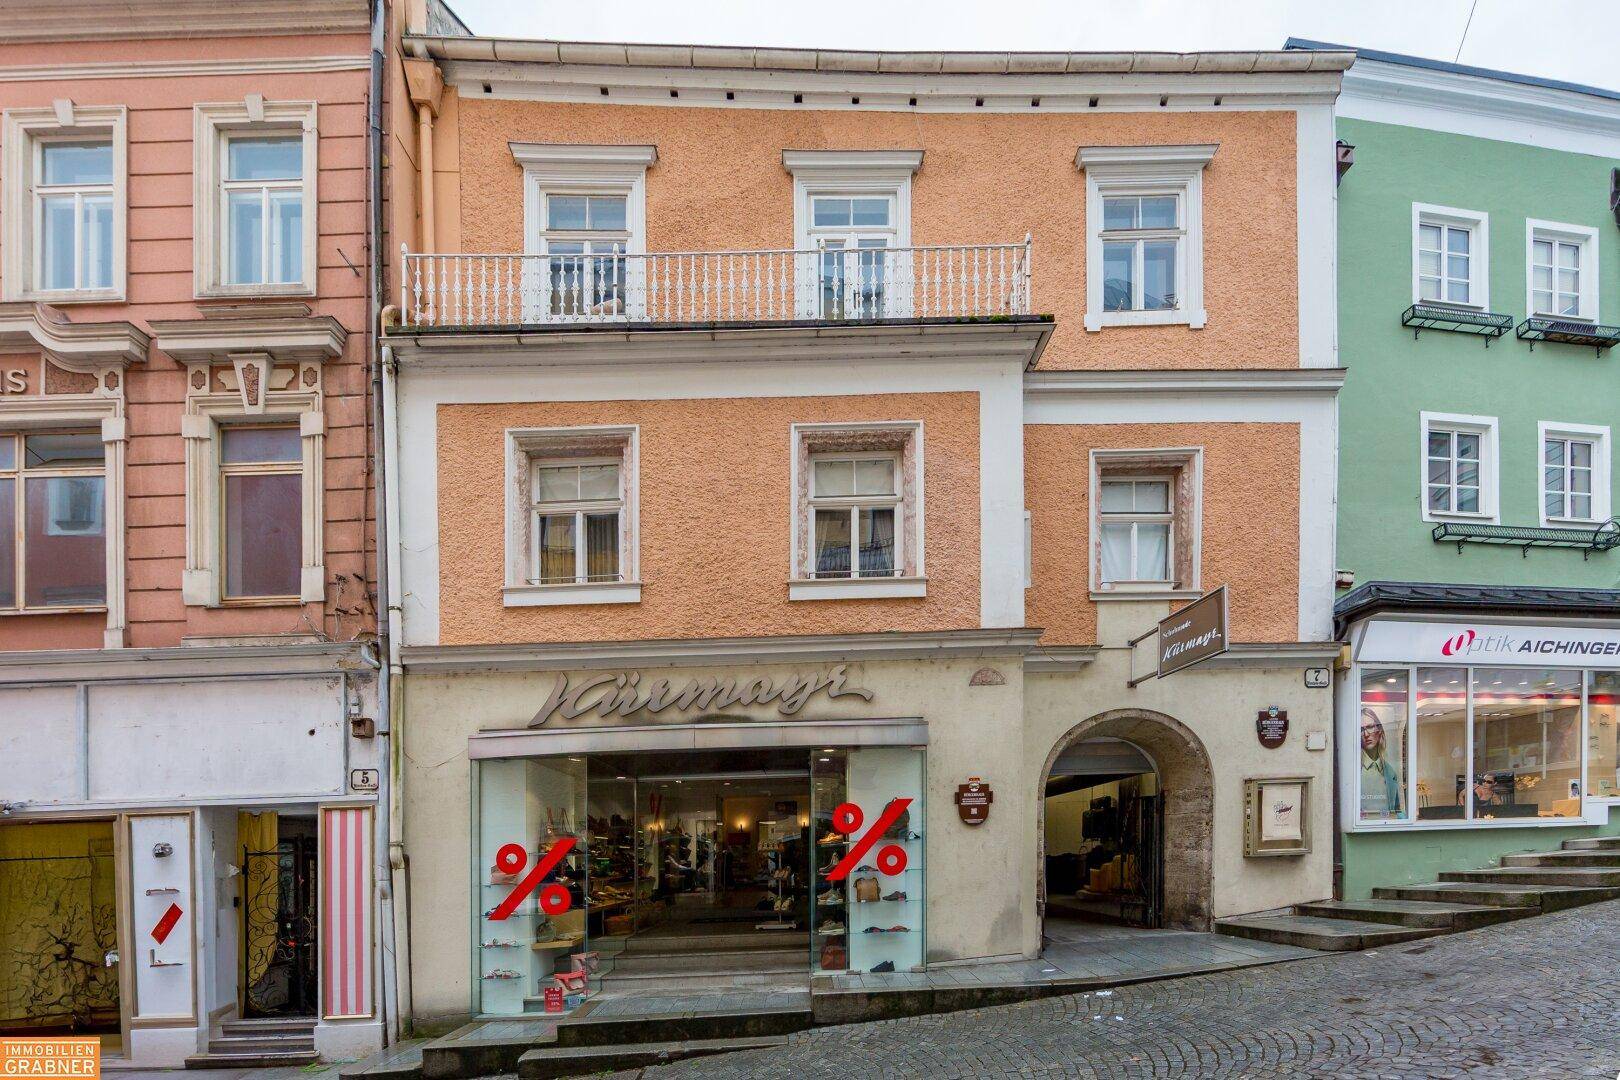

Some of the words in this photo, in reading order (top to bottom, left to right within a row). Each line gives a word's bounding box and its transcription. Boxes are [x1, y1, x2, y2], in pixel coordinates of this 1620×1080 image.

[0, 369, 27, 393] S
[1314, 669, 1321, 681] 7
[528, 664, 873, 729] Kürmayr
[361, 771, 369, 784] 5
